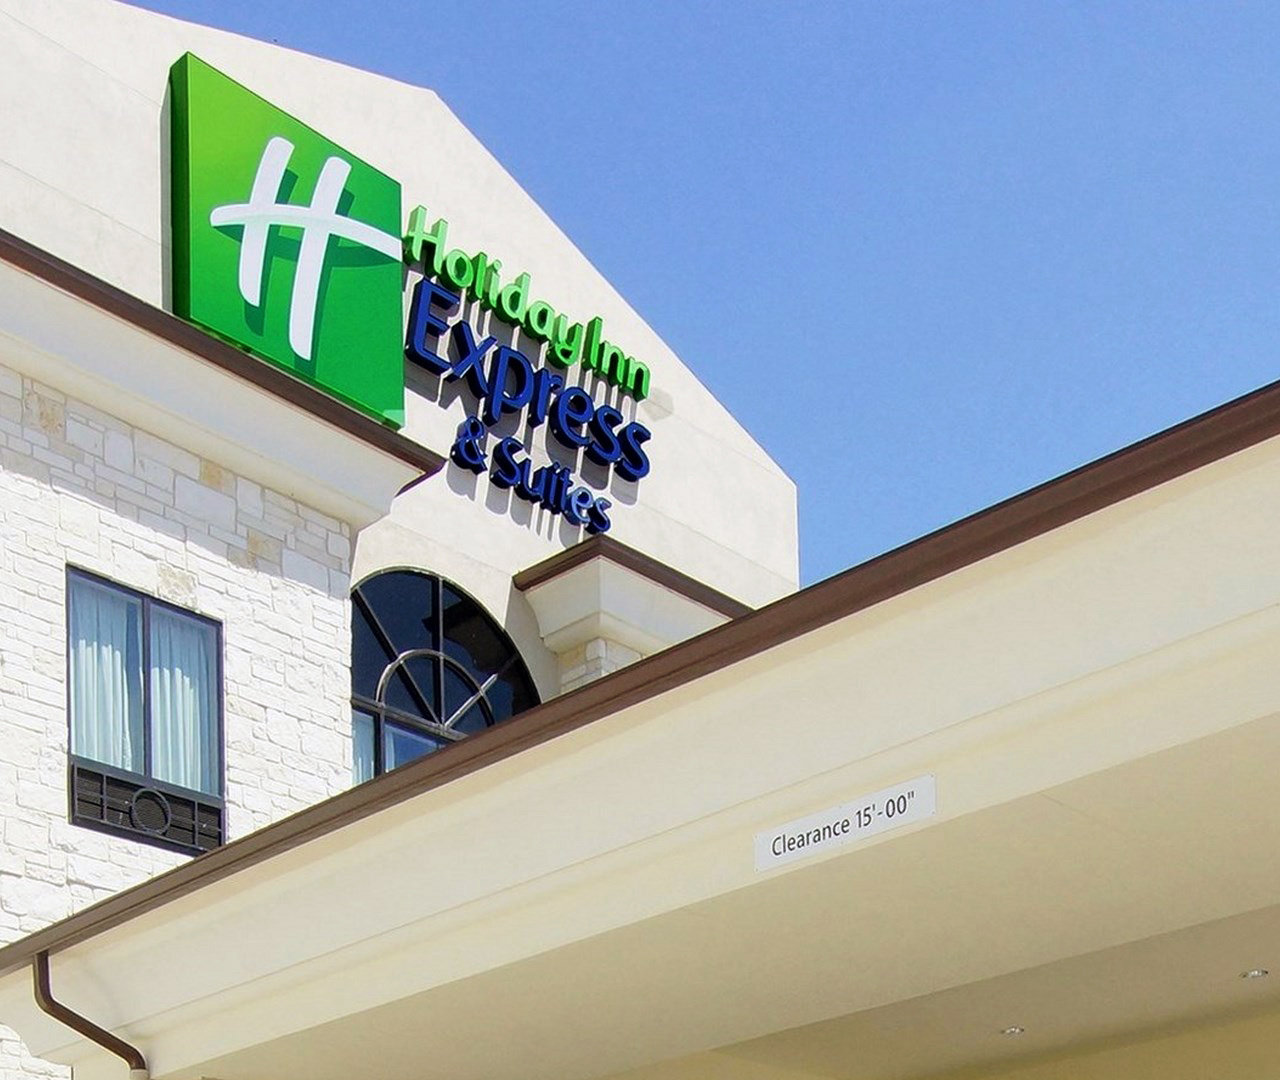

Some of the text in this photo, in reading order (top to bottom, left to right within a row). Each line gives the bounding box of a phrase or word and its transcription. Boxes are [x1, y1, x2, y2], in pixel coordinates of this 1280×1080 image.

[403, 204, 651, 402] Holiday Inn
[404, 276, 652, 483] Express
[450, 416, 613, 535] & Suites
[771, 790, 916, 856] Clearance 15'-00"
